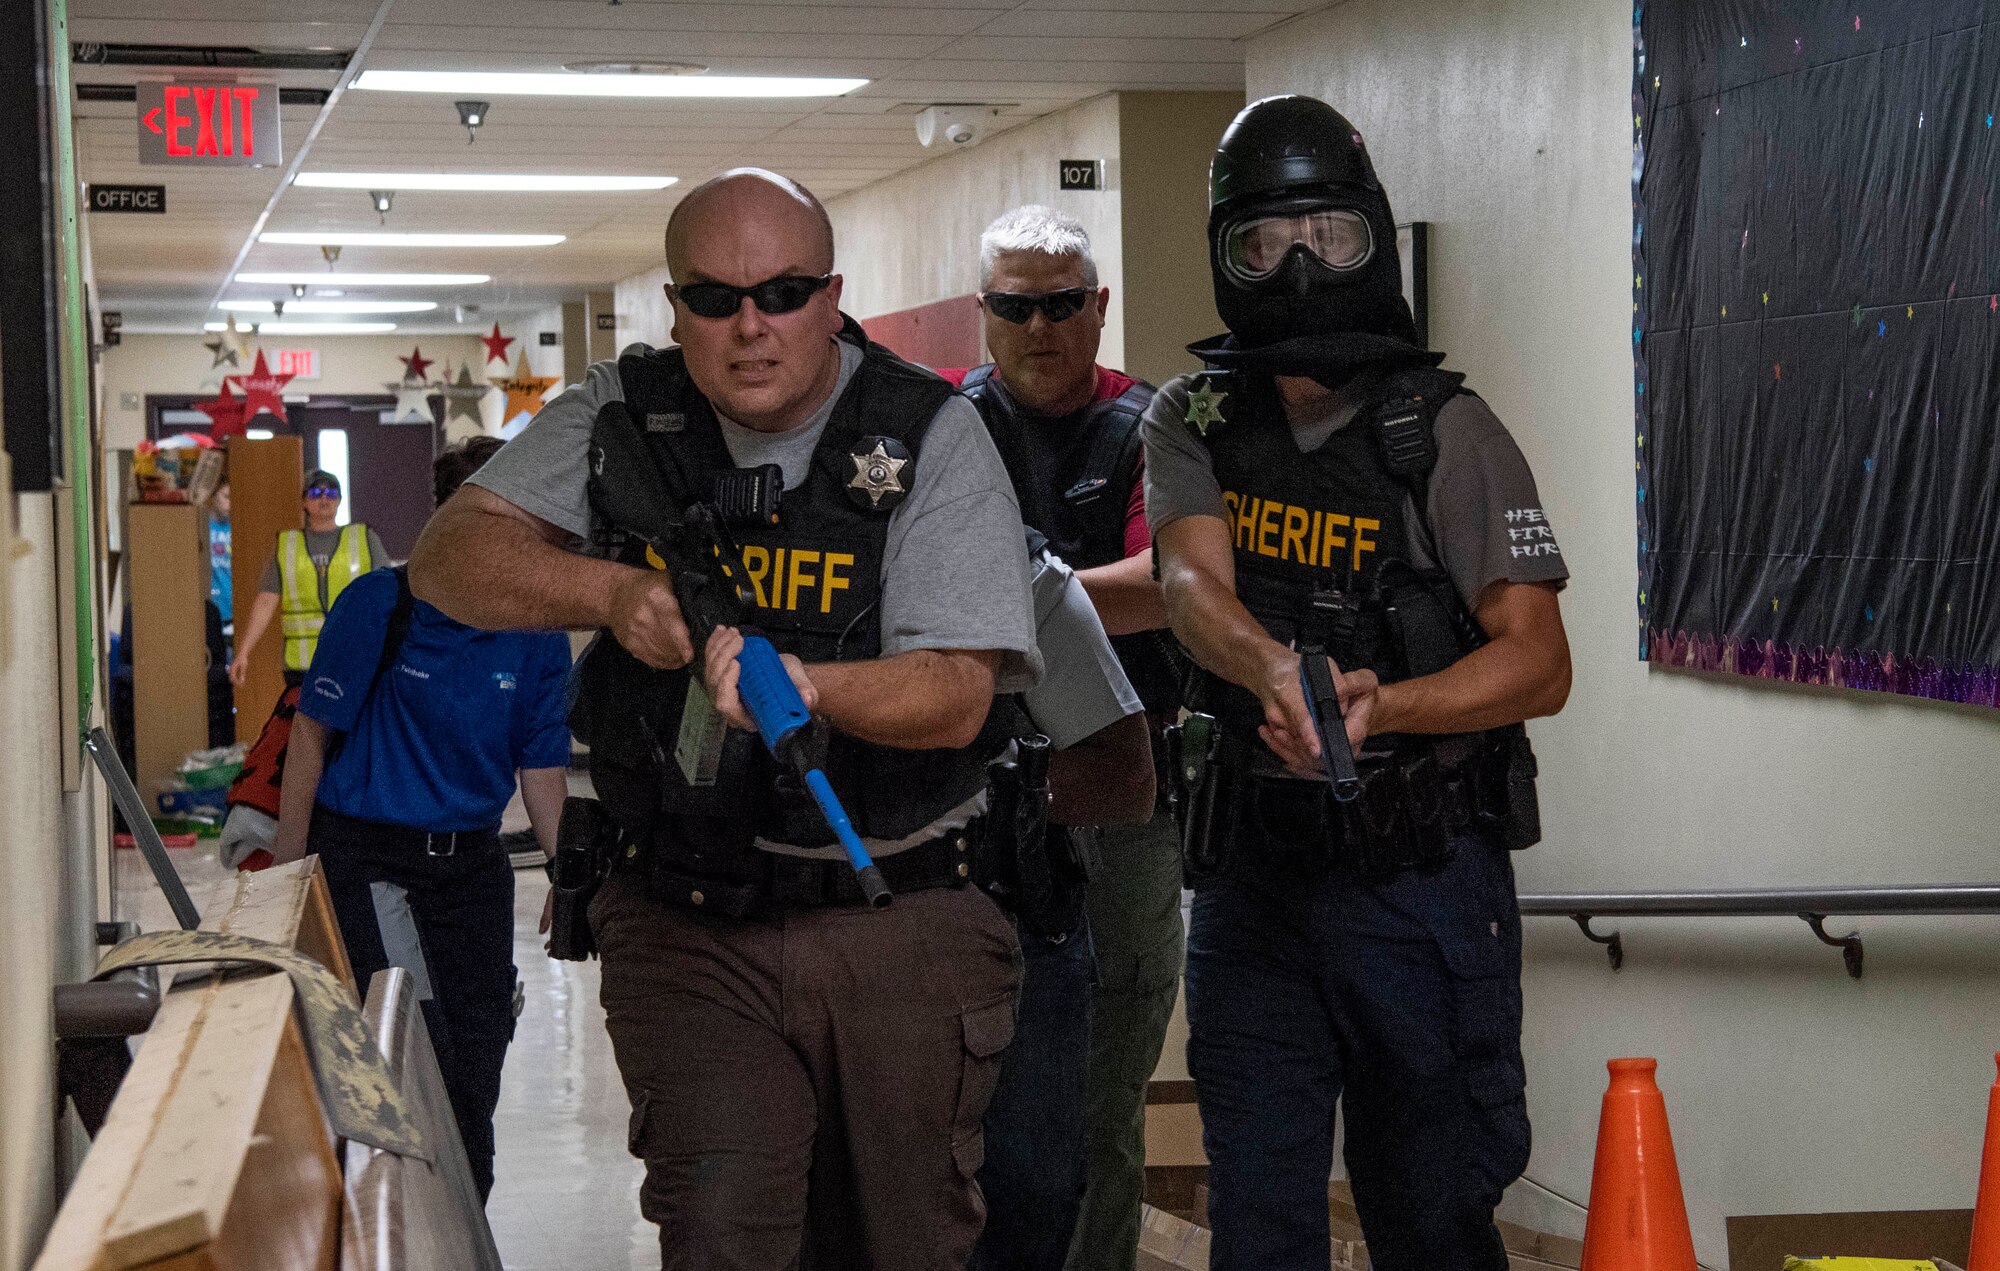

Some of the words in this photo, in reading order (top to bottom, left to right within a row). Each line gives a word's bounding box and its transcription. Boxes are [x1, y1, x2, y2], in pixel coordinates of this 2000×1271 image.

[164, 86, 259, 158] EXIT
[1063, 167, 1092, 184] 107
[97, 191, 159, 208] OFFICE
[279, 351, 312, 377] EXIT
[1384, 414, 1418, 427] MOTOROLA
[1504, 508, 1546, 523] HE
[1222, 490, 1380, 571] SHERIFF
[646, 544, 854, 613] RIFF
